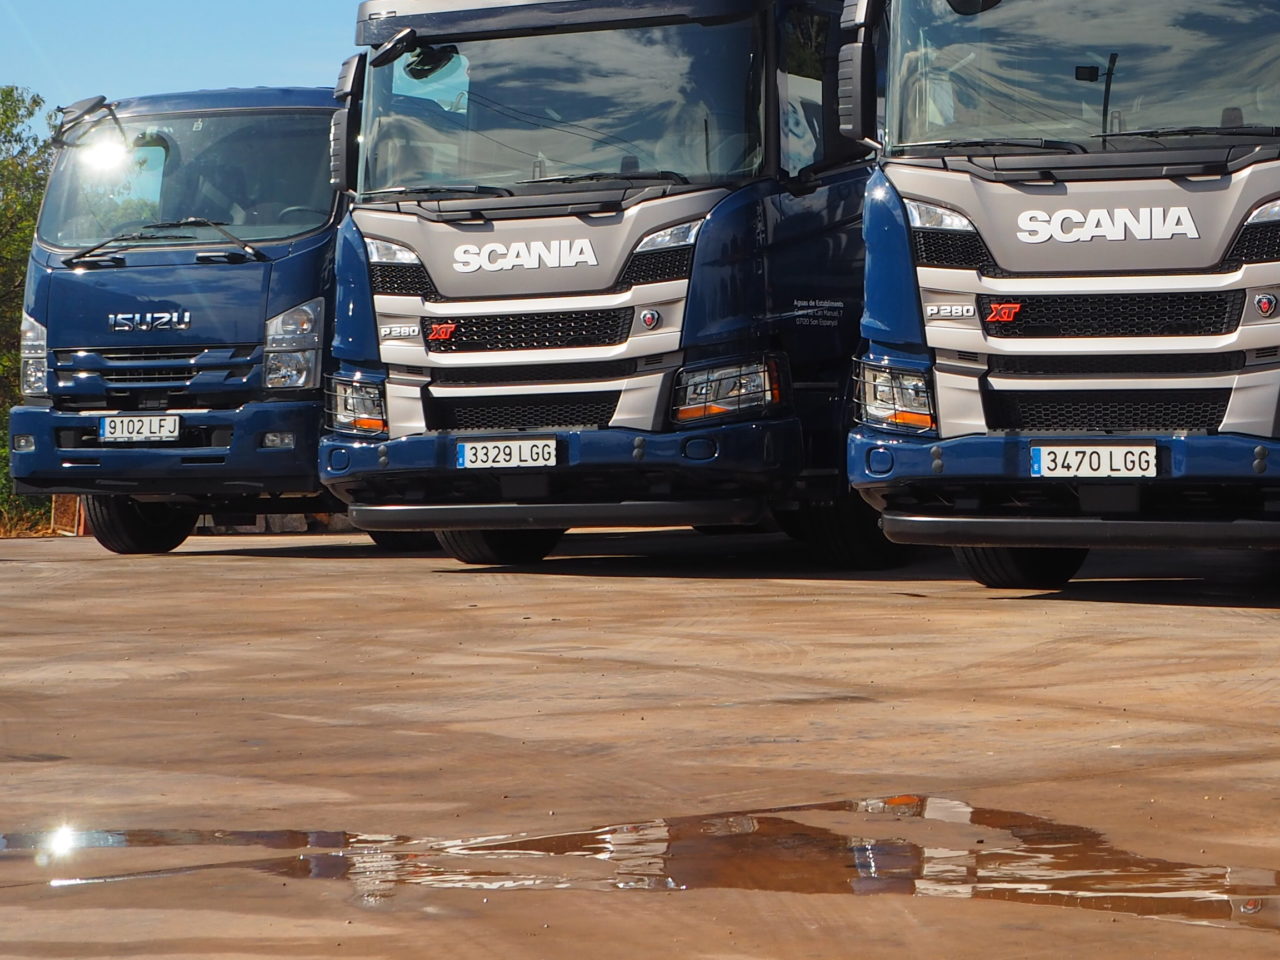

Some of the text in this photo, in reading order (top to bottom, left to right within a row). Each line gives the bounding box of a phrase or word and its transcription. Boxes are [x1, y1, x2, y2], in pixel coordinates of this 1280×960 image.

[1016, 206, 1200, 244] SCANIA
[453, 238, 598, 273] SCANIA
[794, 299, 808, 307] Aguas
[986, 303, 1022, 322] XT
[108, 312, 191, 332] ISUZU
[427, 323, 456, 340] XT
[109, 418, 177, 436] 9102 LFJ
[469, 443, 552, 464] 3329 LGG
[1046, 450, 1150, 472] 3470 LGG
